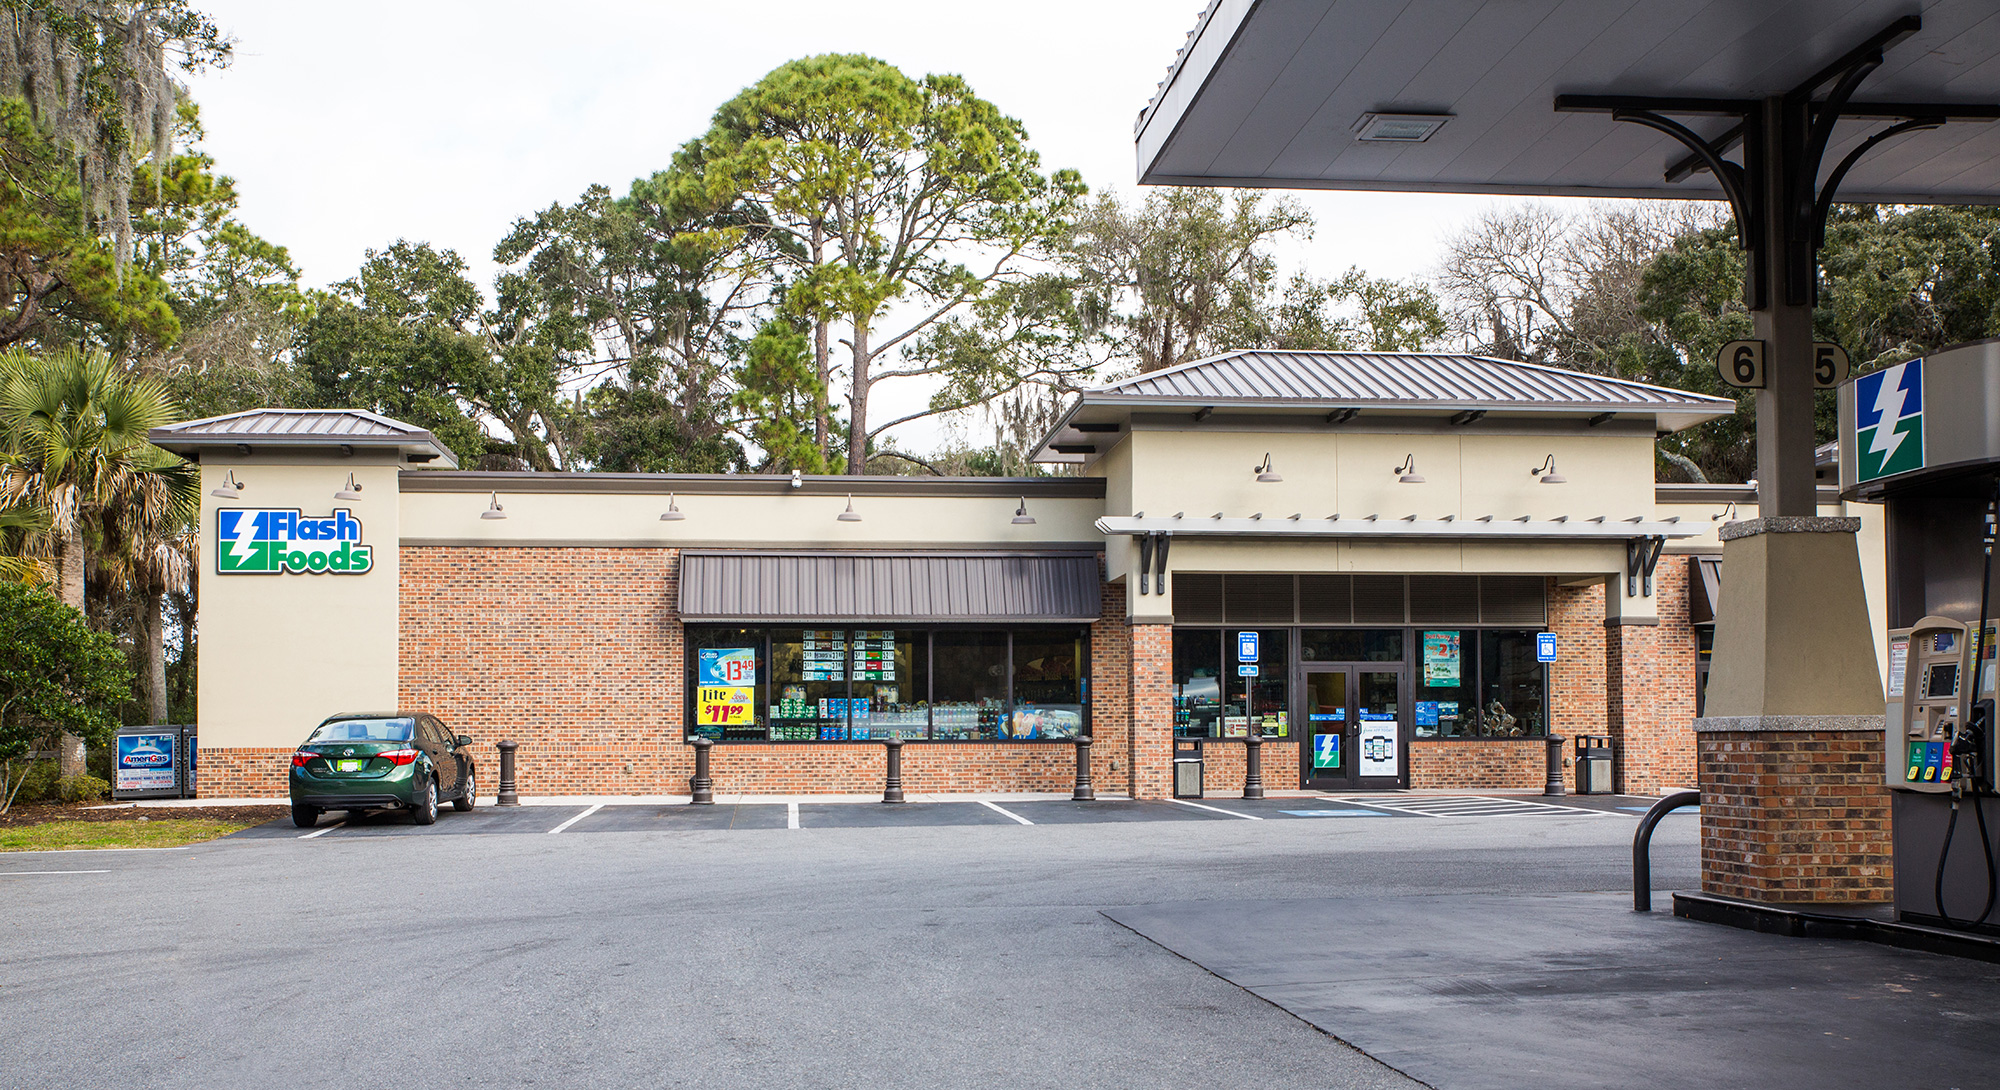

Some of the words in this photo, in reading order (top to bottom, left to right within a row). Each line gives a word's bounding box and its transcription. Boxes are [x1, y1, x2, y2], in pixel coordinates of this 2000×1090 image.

[1733, 346, 1755, 383] 6
[1815, 347, 1836, 385] 5
[269, 511, 358, 540] Flash
[268, 541, 369, 570] Foods
[1438, 643, 1448, 657] 2
[703, 689, 726, 703] Lite
[124, 755, 168, 763] AmeriGas
